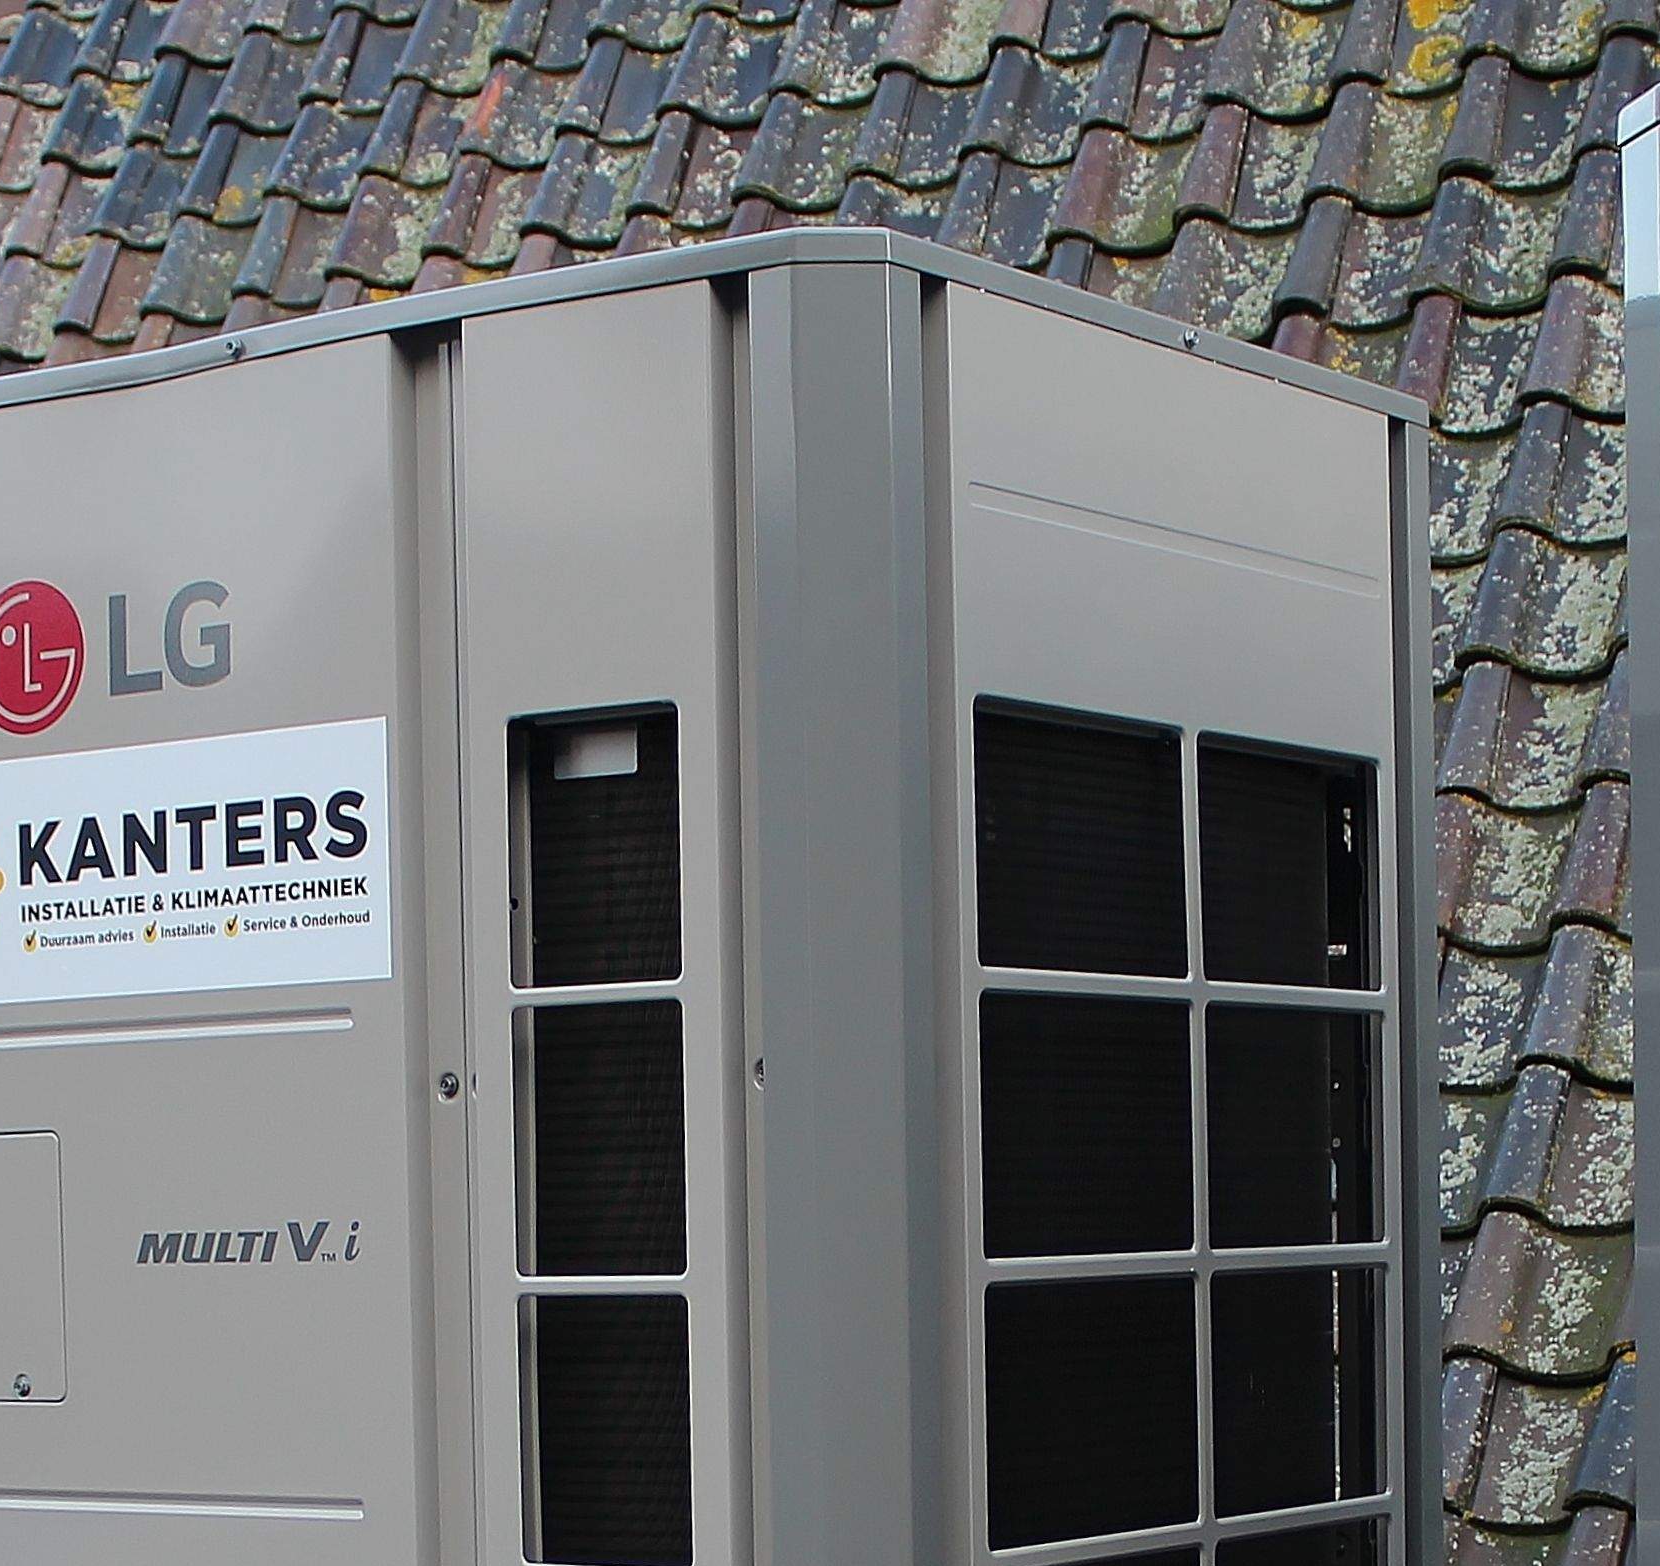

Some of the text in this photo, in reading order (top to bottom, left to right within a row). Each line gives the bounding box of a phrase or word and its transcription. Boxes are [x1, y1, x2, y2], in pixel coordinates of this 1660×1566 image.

[108, 580, 232, 696] LG
[19, 789, 369, 885] KANTERS
[20, 877, 367, 922] INSTALLATIE & KLIMAATTECHNIEK
[40, 910, 370, 947] Duurzaam advies Installatie Service & Onderhoud
[137, 1231, 278, 1264] MULTI
[344, 1221, 360, 1262] i
